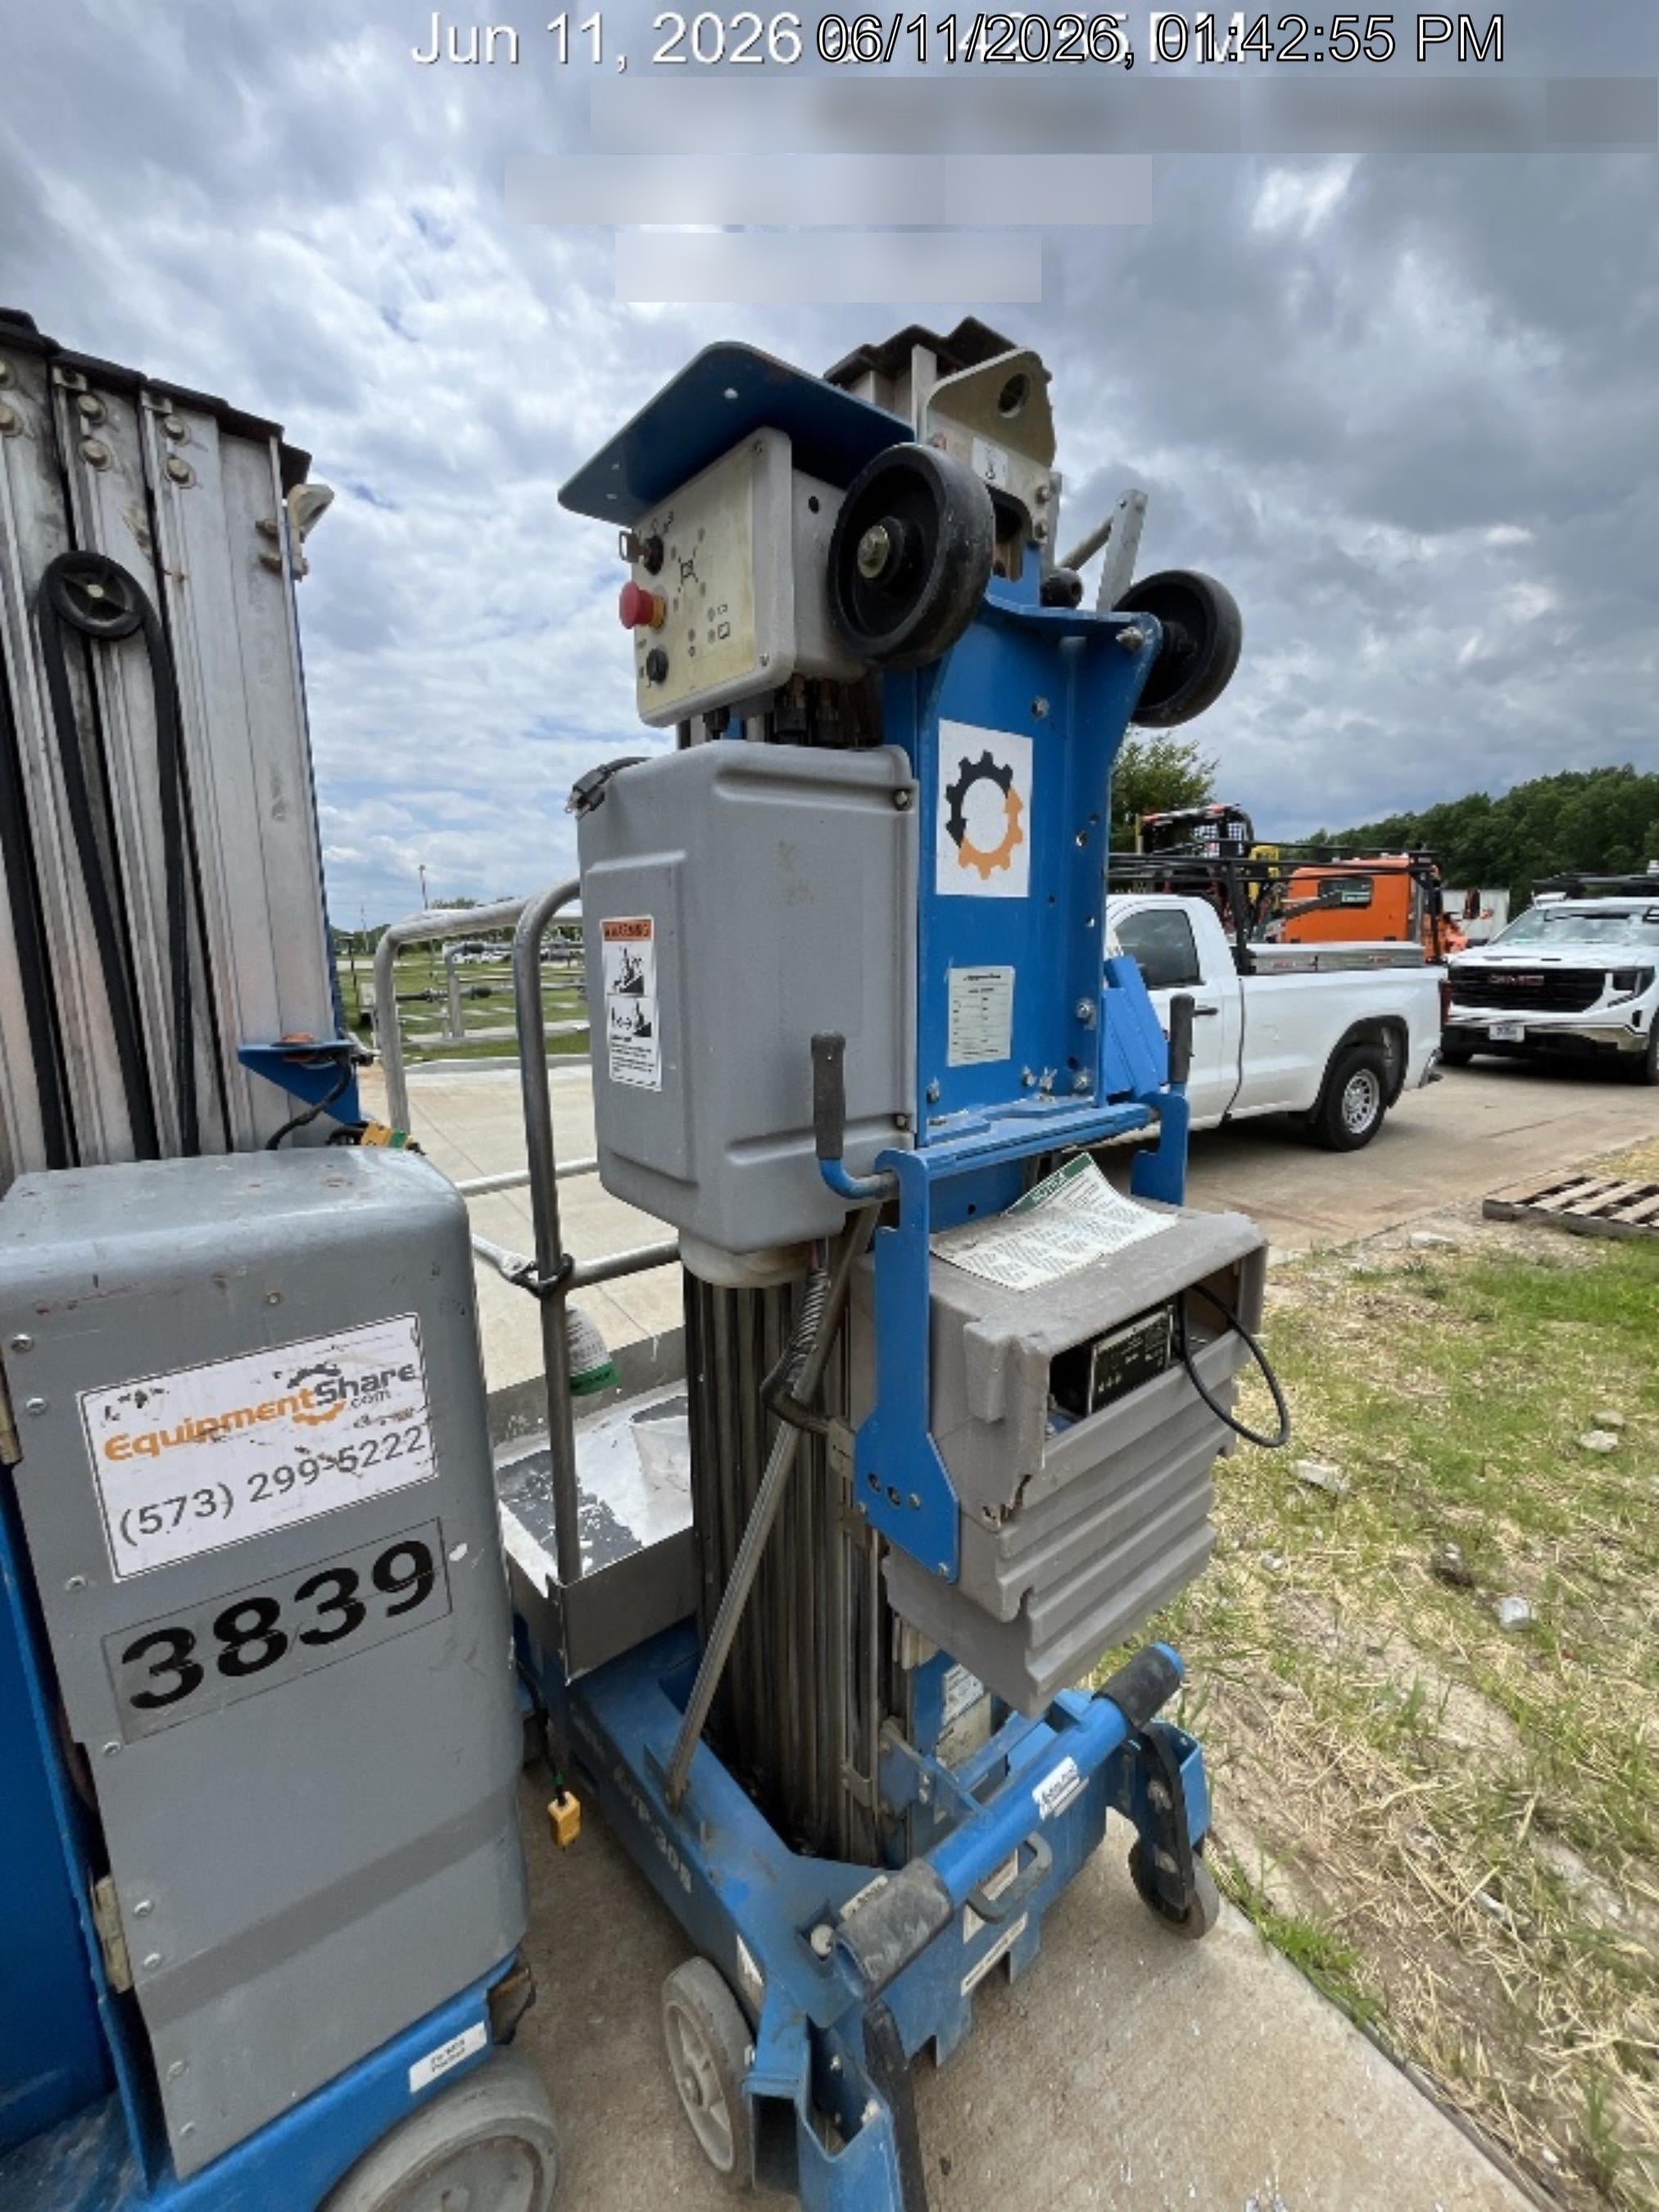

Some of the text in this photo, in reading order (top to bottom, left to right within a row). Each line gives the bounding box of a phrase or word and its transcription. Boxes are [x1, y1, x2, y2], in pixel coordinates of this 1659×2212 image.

[104, 1363, 417, 1462] EquipmentShare
[120, 1425, 426, 1547] (573) 299-5222
[121, 1540, 436, 1710] 3839
